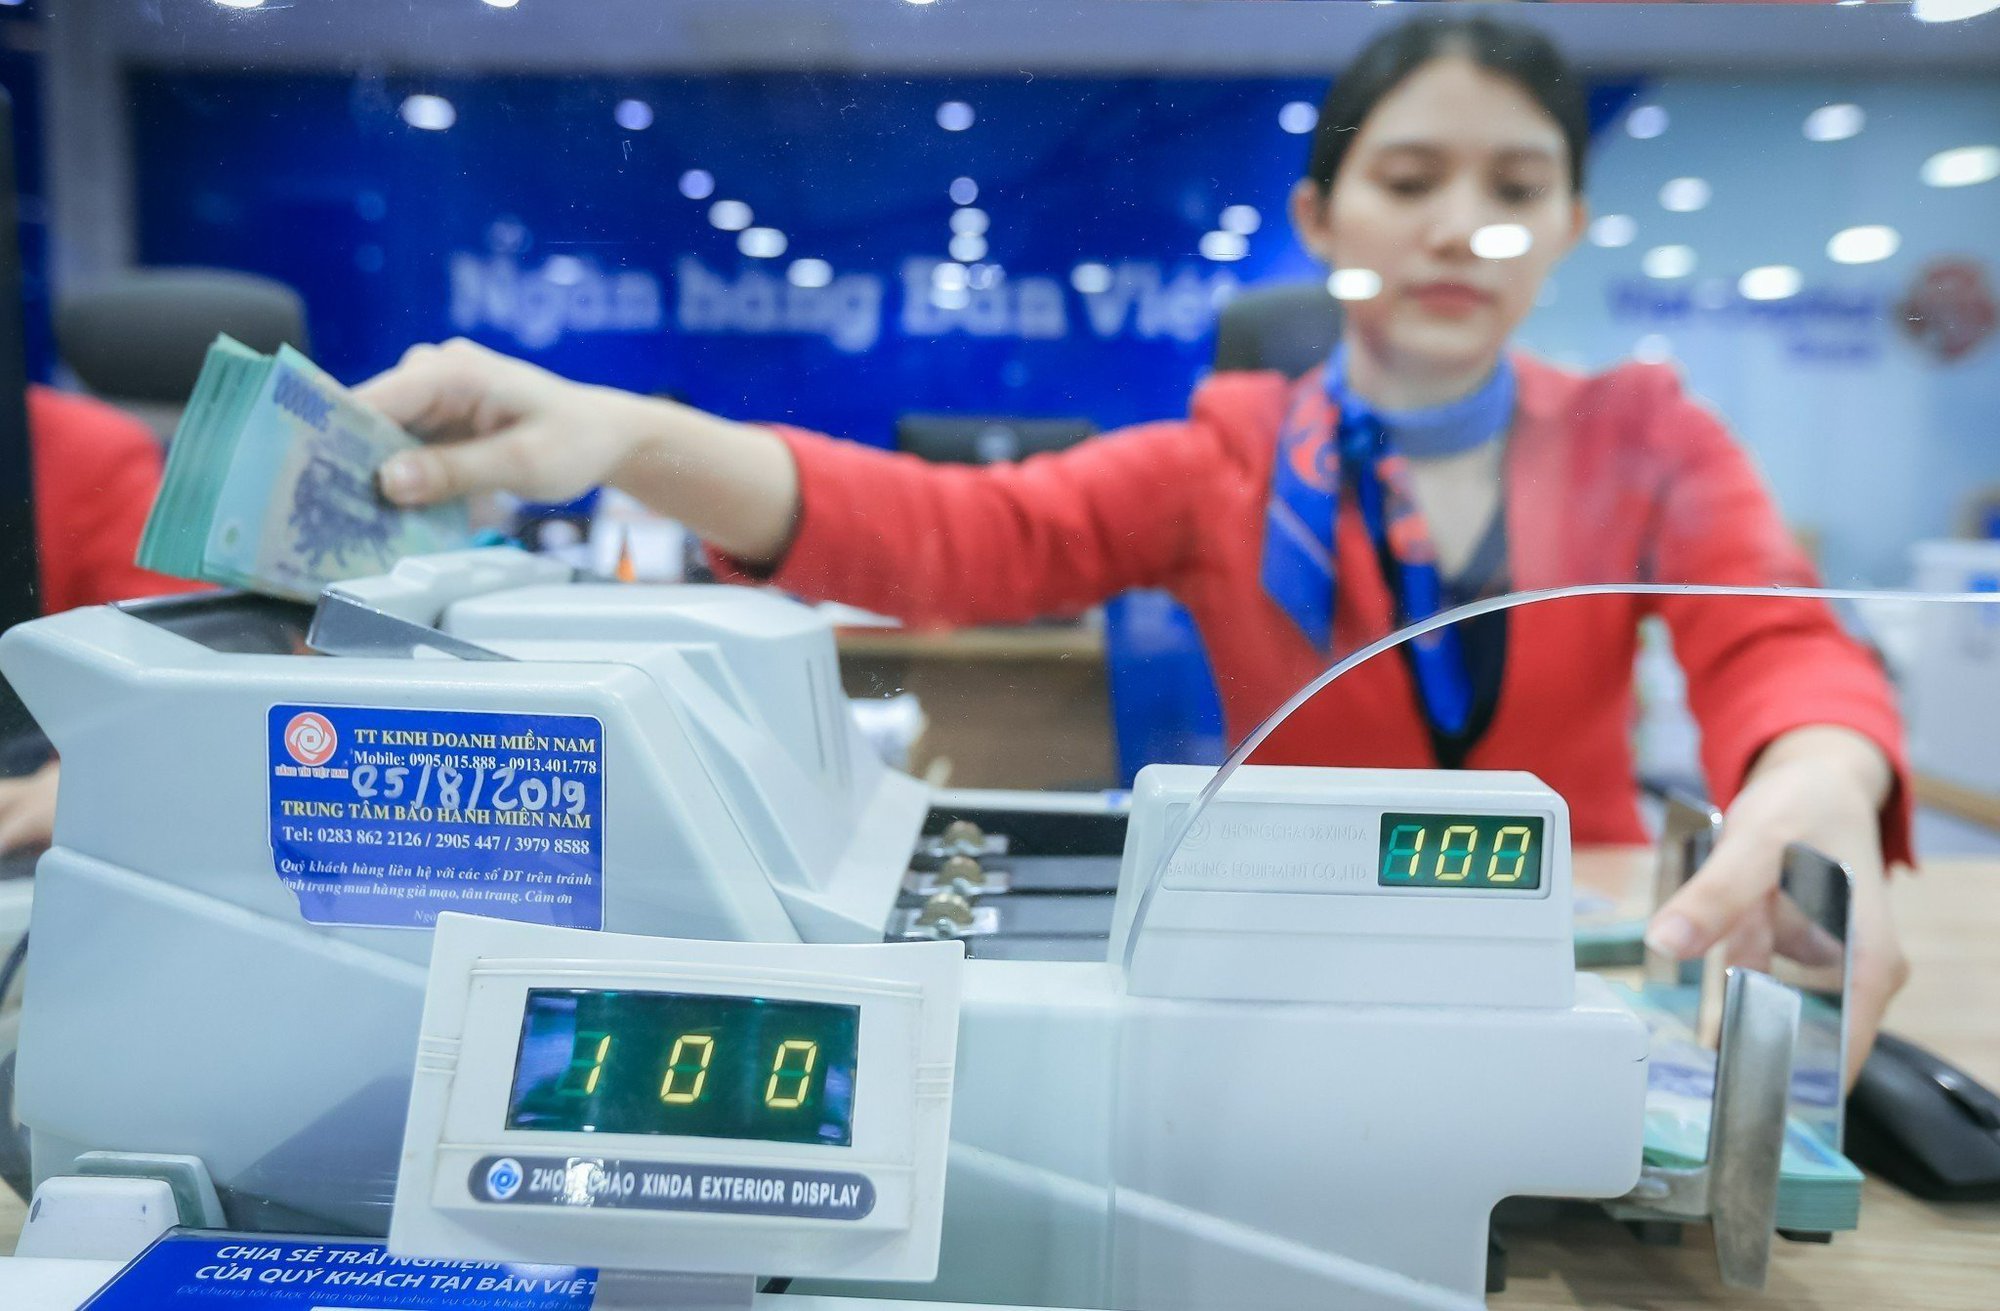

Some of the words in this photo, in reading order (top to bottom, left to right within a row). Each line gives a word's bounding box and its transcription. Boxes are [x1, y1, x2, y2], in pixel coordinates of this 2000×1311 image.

[354, 729, 377, 744] TT
[382, 730, 428, 746] KINH
[432, 732, 496, 749] DOANH
[501, 729, 549, 751] MIỀN
[554, 737, 596, 753] NAM
[354, 750, 405, 766] Mobile:
[409, 753, 496, 769] 0905.015.888
[509, 757, 597, 774] 0913.401.778
[281, 800, 344, 818] TRUNG
[349, 800, 390, 820] TÂM
[394, 800, 433, 822] BẢO
[549, 812, 592, 829] NAM
[283, 826, 313, 842] Tel:
[317, 828, 353, 844] 0283
[356, 829, 382, 845] 862
[387, 831, 422, 847] 2126
[425, 833, 432, 847] /
[435, 833, 470, 849] 2905
[474, 835, 501, 850] 447
[504, 836, 511, 851] /
[514, 837, 550, 852] 3979
[554, 838, 590, 854] 8588
[1408, 825, 1531, 882] 100
[309, 860, 349, 874] khách
[352, 862, 385, 878] hàng
[388, 864, 412, 877] liên
[416, 864, 432, 880] hệ
[436, 866, 456, 880] với
[458, 869, 481, 881] các
[484, 867, 501, 881] số
[526, 872, 552, 884] trên
[556, 873, 592, 886] tránh
[307, 881, 342, 896] trạng
[343, 885, 370, 894] mua
[372, 883, 404, 898] hàng
[406, 885, 427, 899] giả
[462, 888, 482, 900] tân
[556, 894, 573, 905] ơn
[640, 1172, 693, 1198] XINDA
[700, 1175, 785, 1203] EXTERIOR
[791, 1180, 860, 1207] DISPLAY
[216, 1245, 282, 1261] CHIA
[195, 1262, 254, 1281] CỦA
[257, 1267, 326, 1284] QUÝ
[322, 1269, 426, 1289] KHÁCH
[430, 1274, 471, 1293] TẠI
[475, 1274, 537, 1293] BẢN
[542, 1277, 598, 1298] VIỆT
